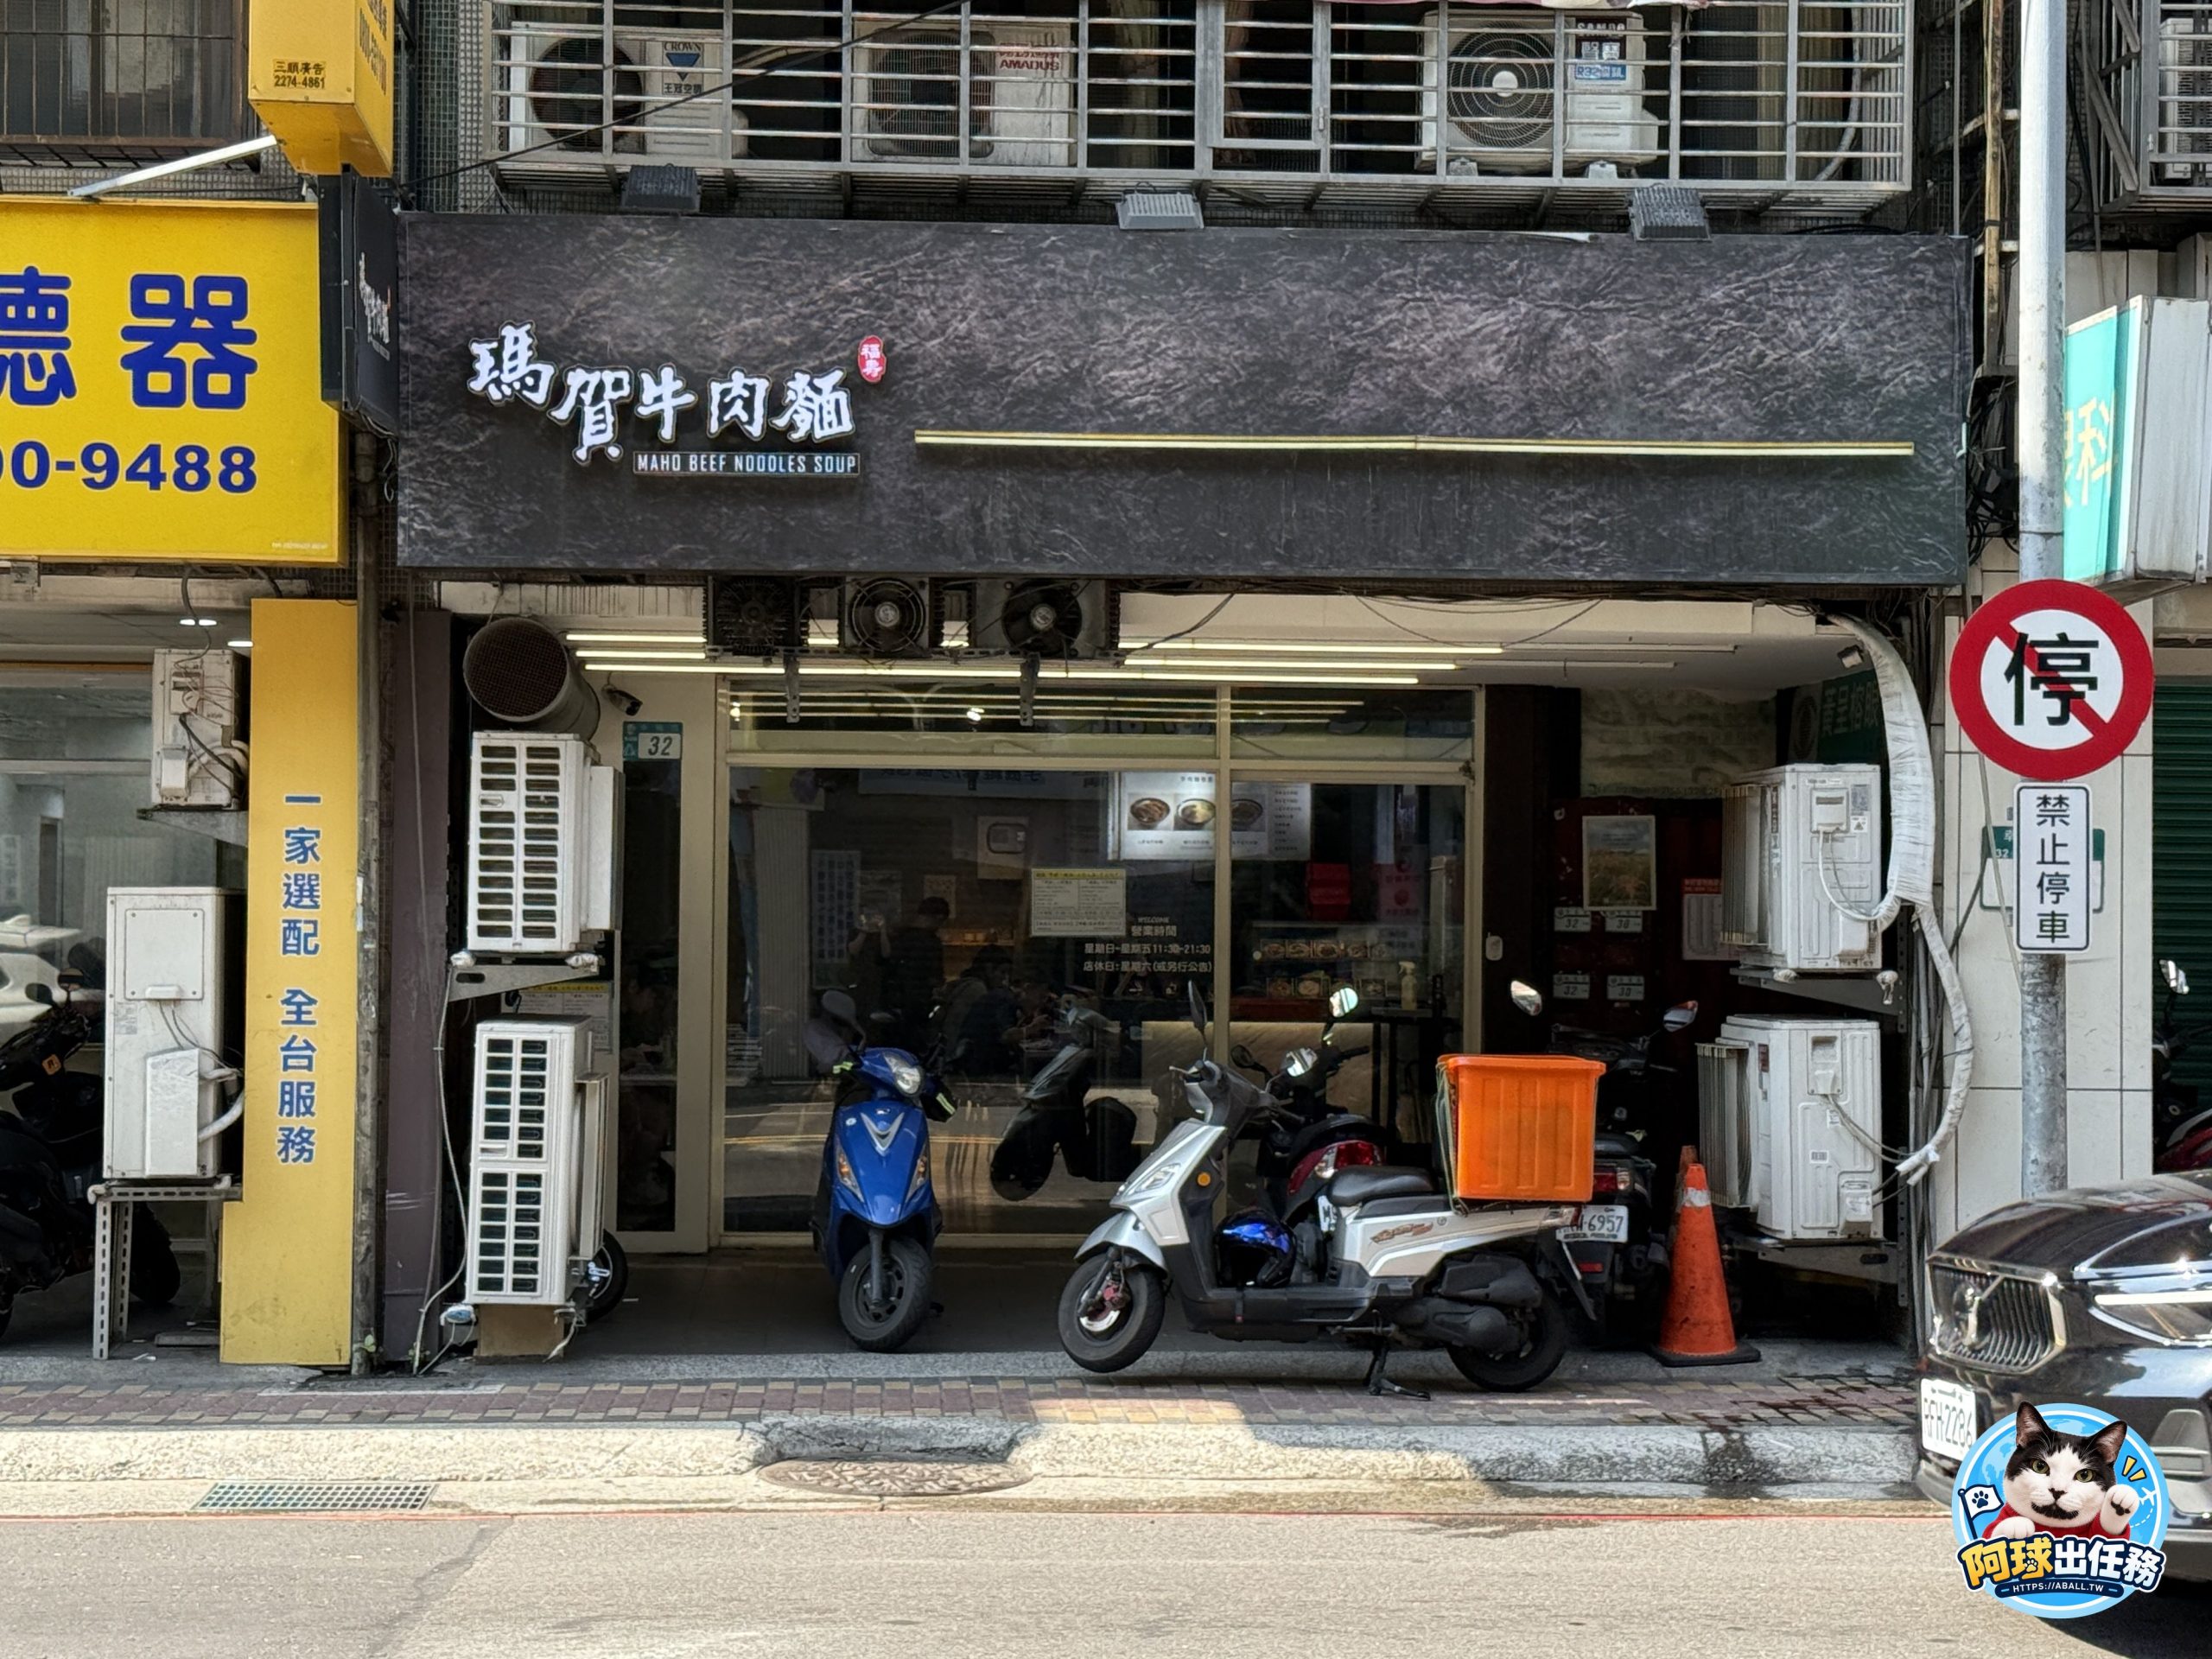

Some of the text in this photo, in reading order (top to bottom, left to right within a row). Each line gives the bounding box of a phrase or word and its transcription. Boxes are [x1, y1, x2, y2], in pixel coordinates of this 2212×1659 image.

[664, 41, 702, 51] CROWN
[467, 321, 856, 462] 瑪賀牛肉麵
[0, 440, 257, 493] 0-9488
[638, 454, 856, 474] MAHO BEEF NOODLES SOUP
[2064, 397, 2117, 508] 科
[2004, 632, 2100, 726] 停
[648, 735, 673, 756] 32
[2036, 794, 2070, 944] 禁止停車
[1131, 925, 1178, 937] 營業時間
[276, 795, 321, 1164] 一家選配 全台服務
